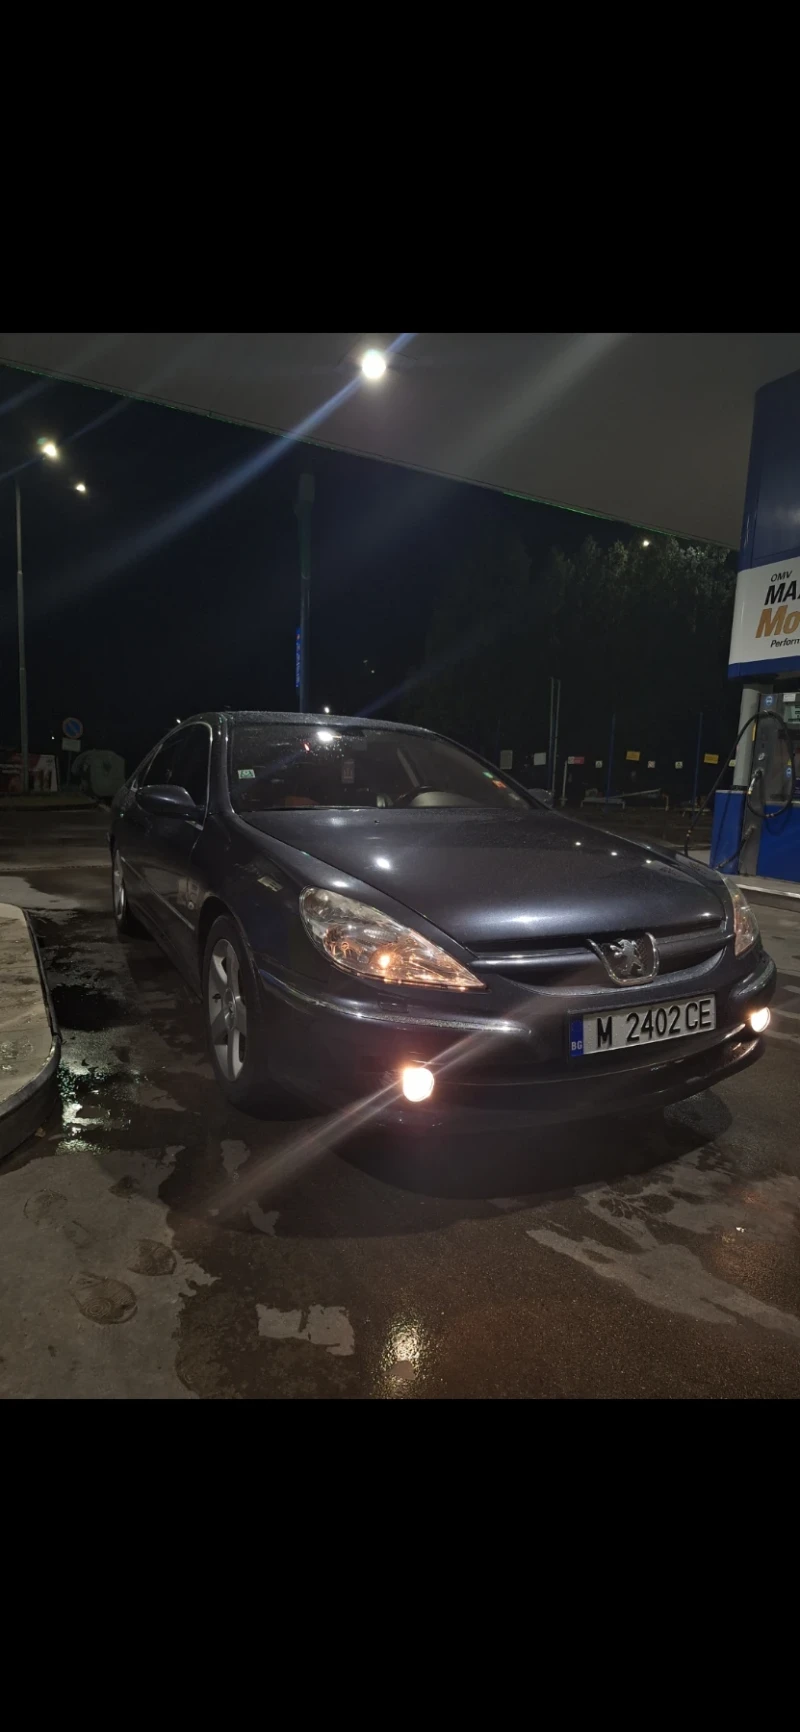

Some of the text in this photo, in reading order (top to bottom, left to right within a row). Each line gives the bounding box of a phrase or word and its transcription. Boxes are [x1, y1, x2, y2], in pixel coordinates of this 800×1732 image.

[771, 570, 793, 582] OMV
[764, 580, 800, 605] MA
[597, 1016, 613, 1048] M
[571, 1040, 583, 1051] BG
